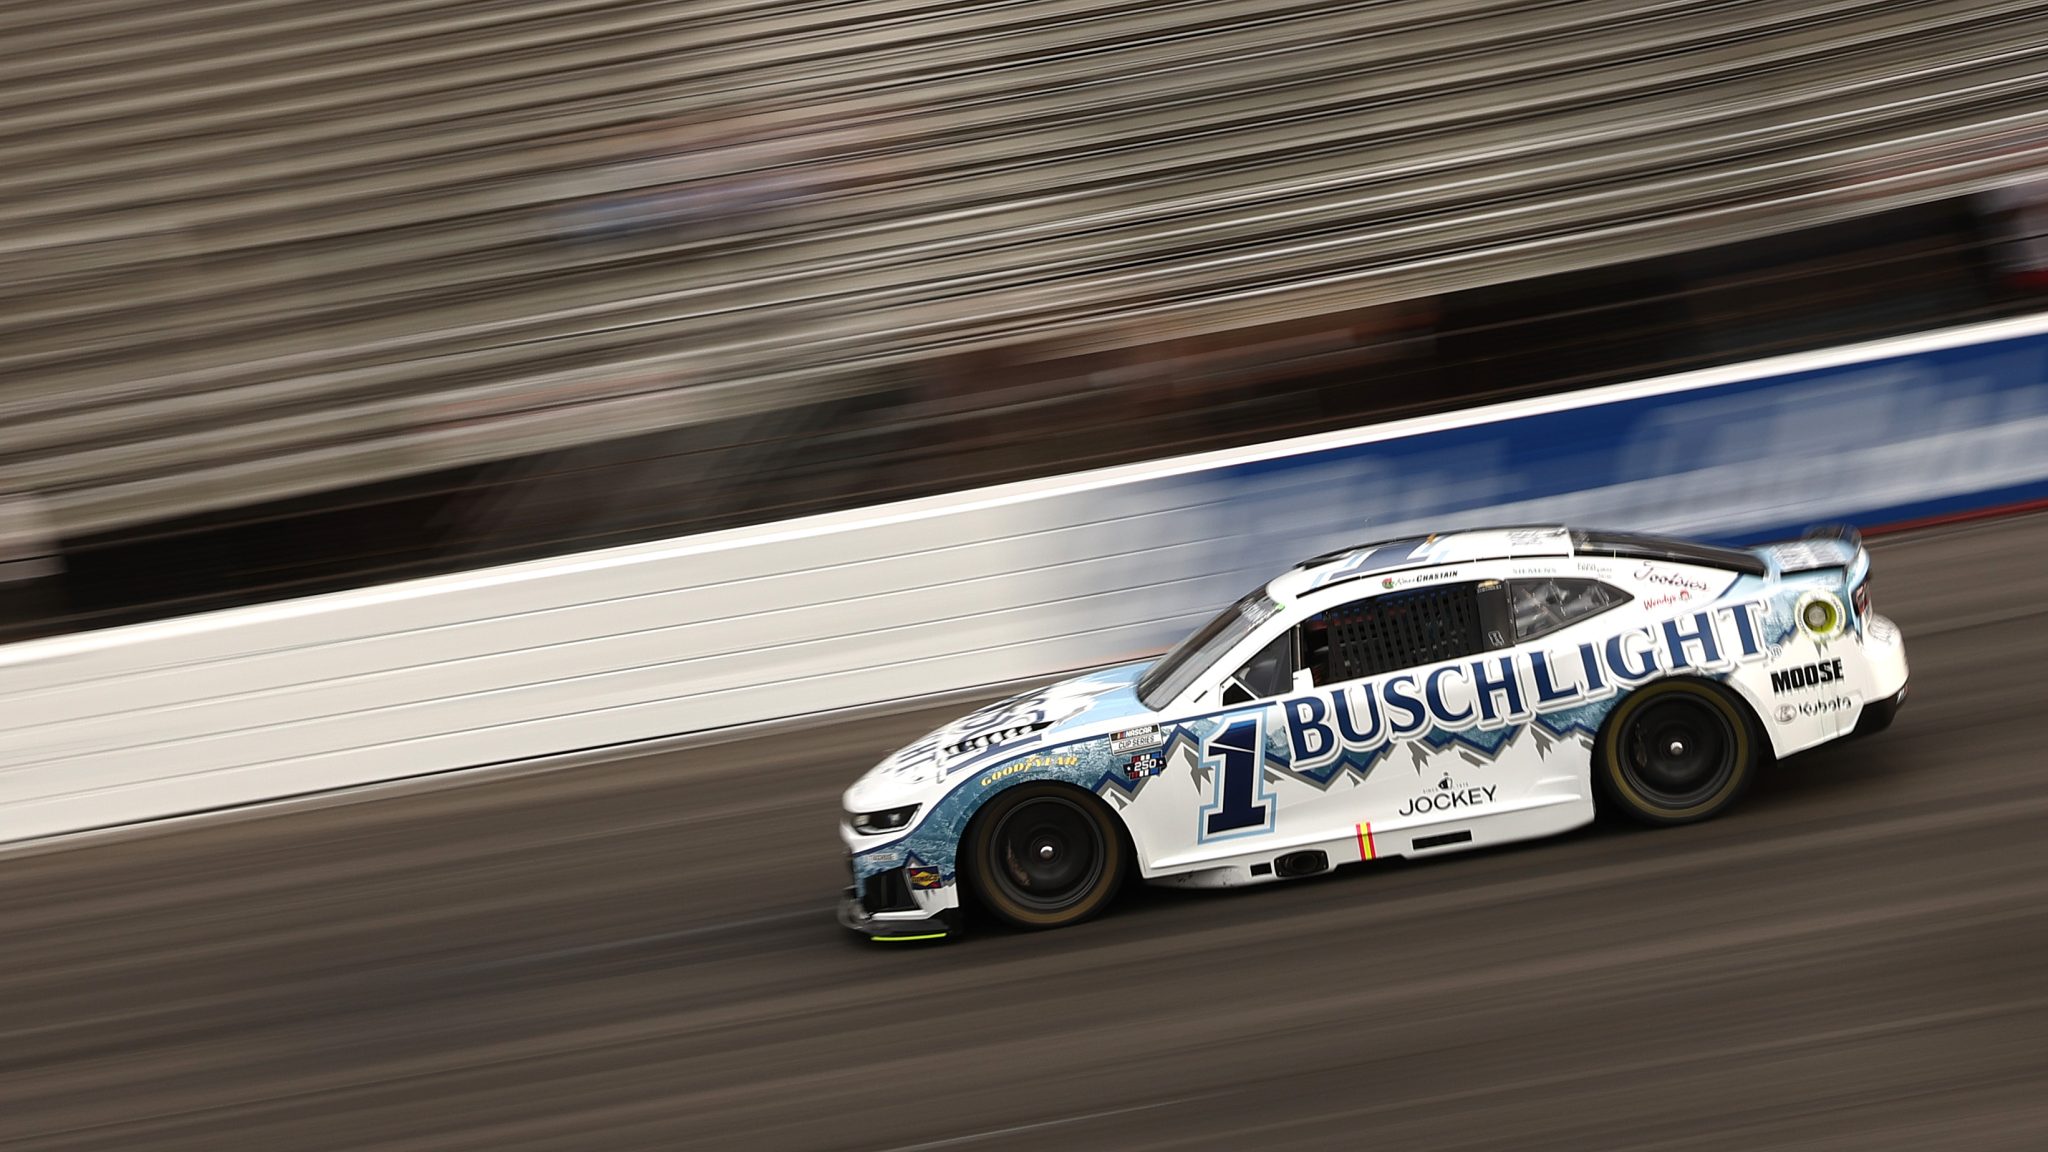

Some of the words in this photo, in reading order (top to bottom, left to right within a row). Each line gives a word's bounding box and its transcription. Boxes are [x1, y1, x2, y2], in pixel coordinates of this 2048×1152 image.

[1416, 570, 1458, 583] CHASTAIN
[1633, 561, 1709, 591] Tootsies
[1643, 592, 1677, 611] Wendy's
[1770, 658, 1844, 693] MOOSE
[1799, 696, 1852, 716] Kubota
[1125, 726, 1153, 737] NASCAR
[1118, 739, 1132, 749] CUP
[1132, 735, 1155, 747] SERIES
[980, 754, 1078, 786] GOODYEAR
[1134, 758, 1157, 772] 250
[1202, 712, 1273, 840] 1
[1398, 784, 1497, 816] JOCKEY
